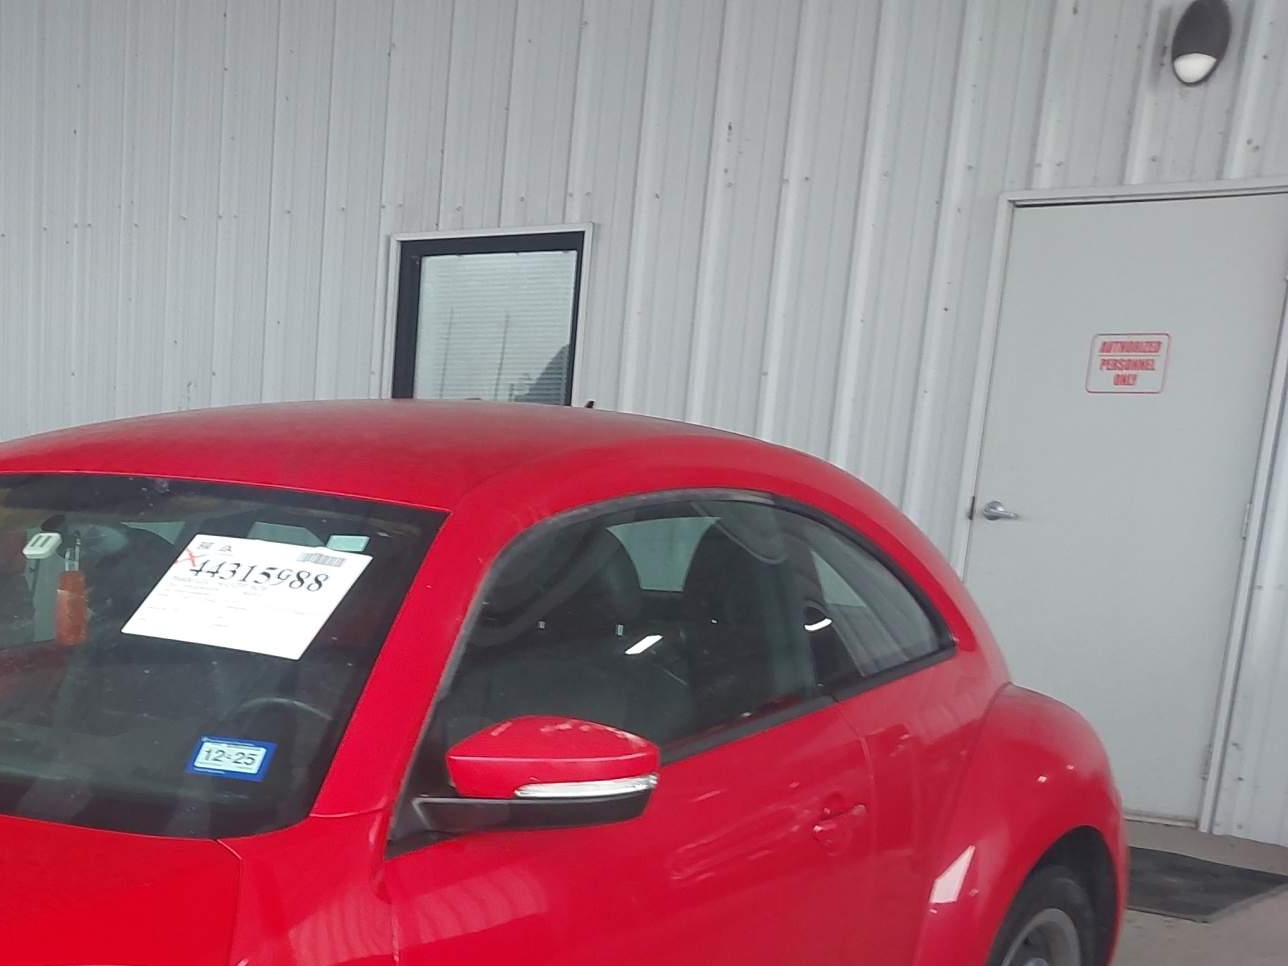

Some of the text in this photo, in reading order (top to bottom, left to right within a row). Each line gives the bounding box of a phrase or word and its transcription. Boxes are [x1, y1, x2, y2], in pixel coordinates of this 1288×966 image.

[1100, 358, 1155, 371] PERSONNEL
[1113, 374, 1137, 386] ONLY
[189, 559, 330, 592] 44315988
[204, 748, 258, 766] 12-25
